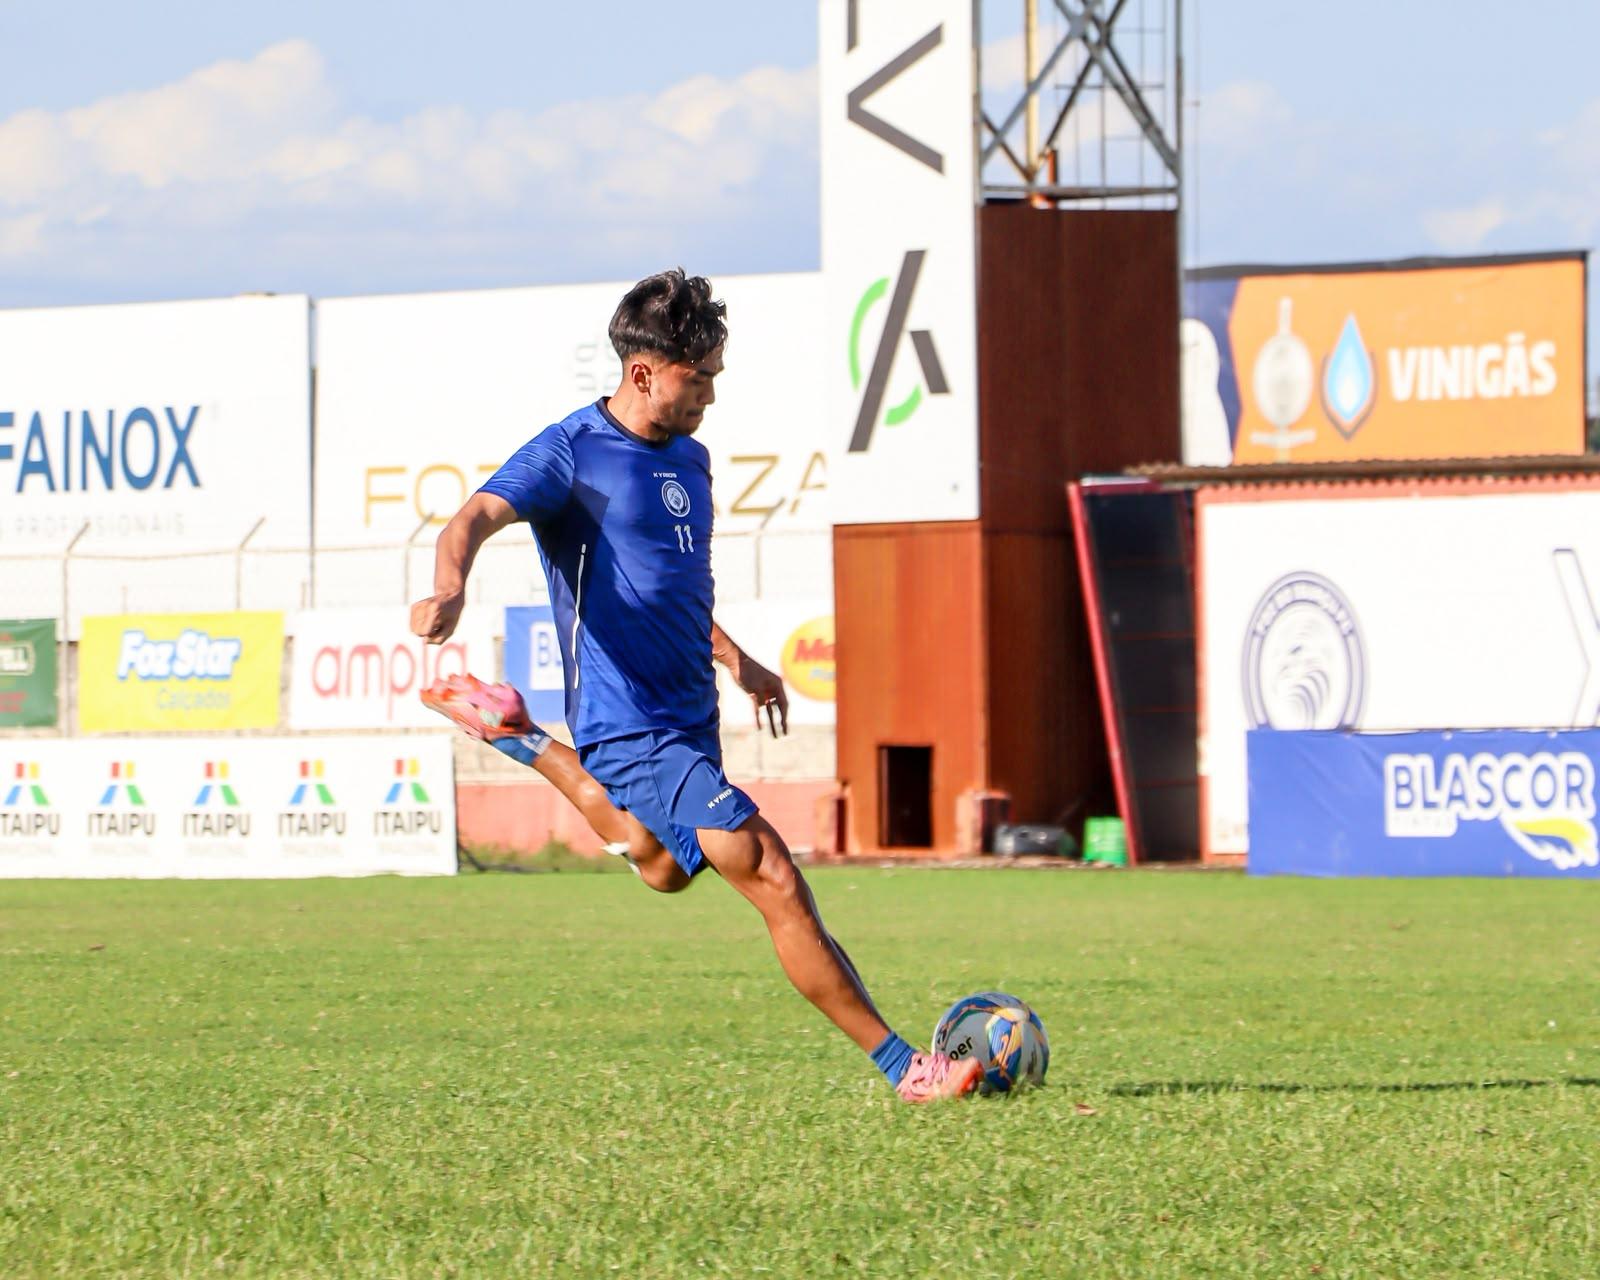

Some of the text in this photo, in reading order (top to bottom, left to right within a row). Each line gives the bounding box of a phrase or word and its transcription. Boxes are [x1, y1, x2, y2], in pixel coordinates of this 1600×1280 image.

[674, 524, 694, 554] 11
[118, 628, 242, 681] Foz Star
[707, 787, 733, 809] KYRIO
[1393, 763, 1588, 810] BLASCOR
[0, 811, 60, 837] TAIPU
[87, 811, 156, 837] ITAIPU
[182, 811, 251, 837] ITAIPU
[278, 810, 347, 837] ITAIPU
[373, 809, 442, 837] ITAIPU
